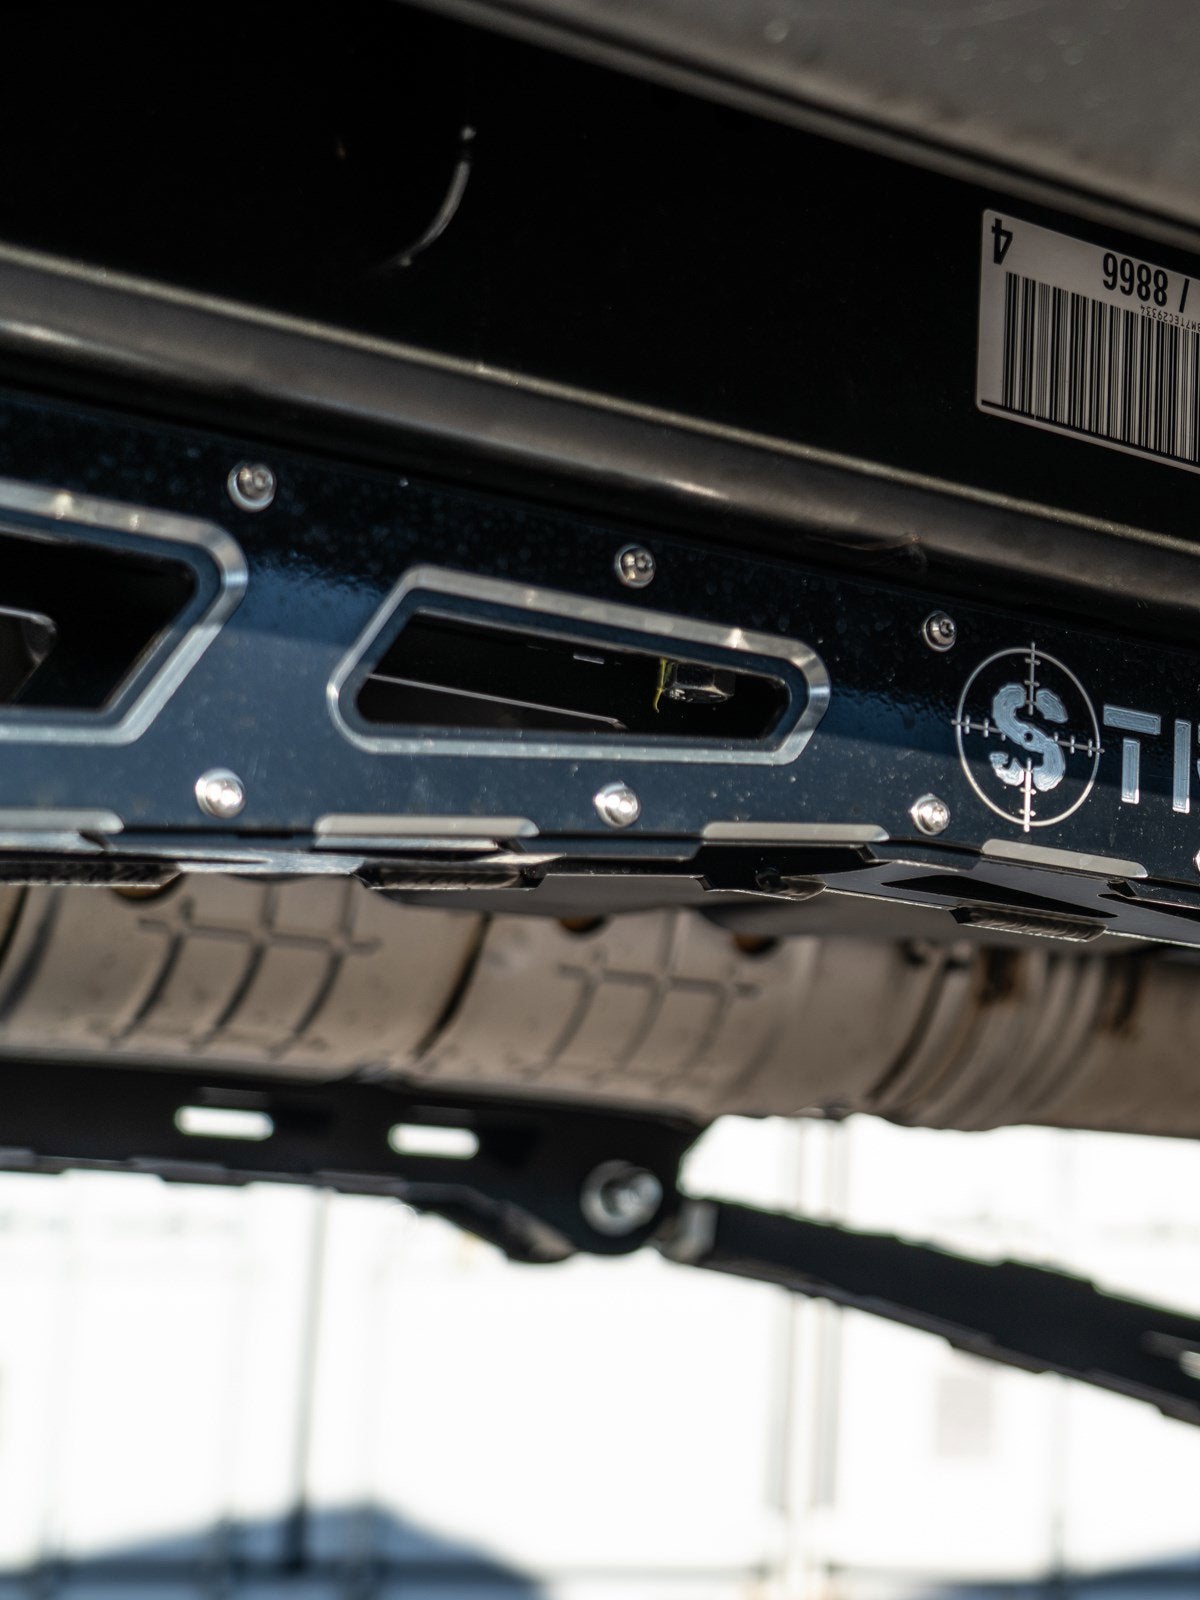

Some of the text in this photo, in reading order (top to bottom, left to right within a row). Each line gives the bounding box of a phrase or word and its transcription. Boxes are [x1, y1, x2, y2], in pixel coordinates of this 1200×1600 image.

[990, 218, 1014, 265] 4
[1102, 252, 1168, 307] 8866
[1178, 278, 1190, 313] /
